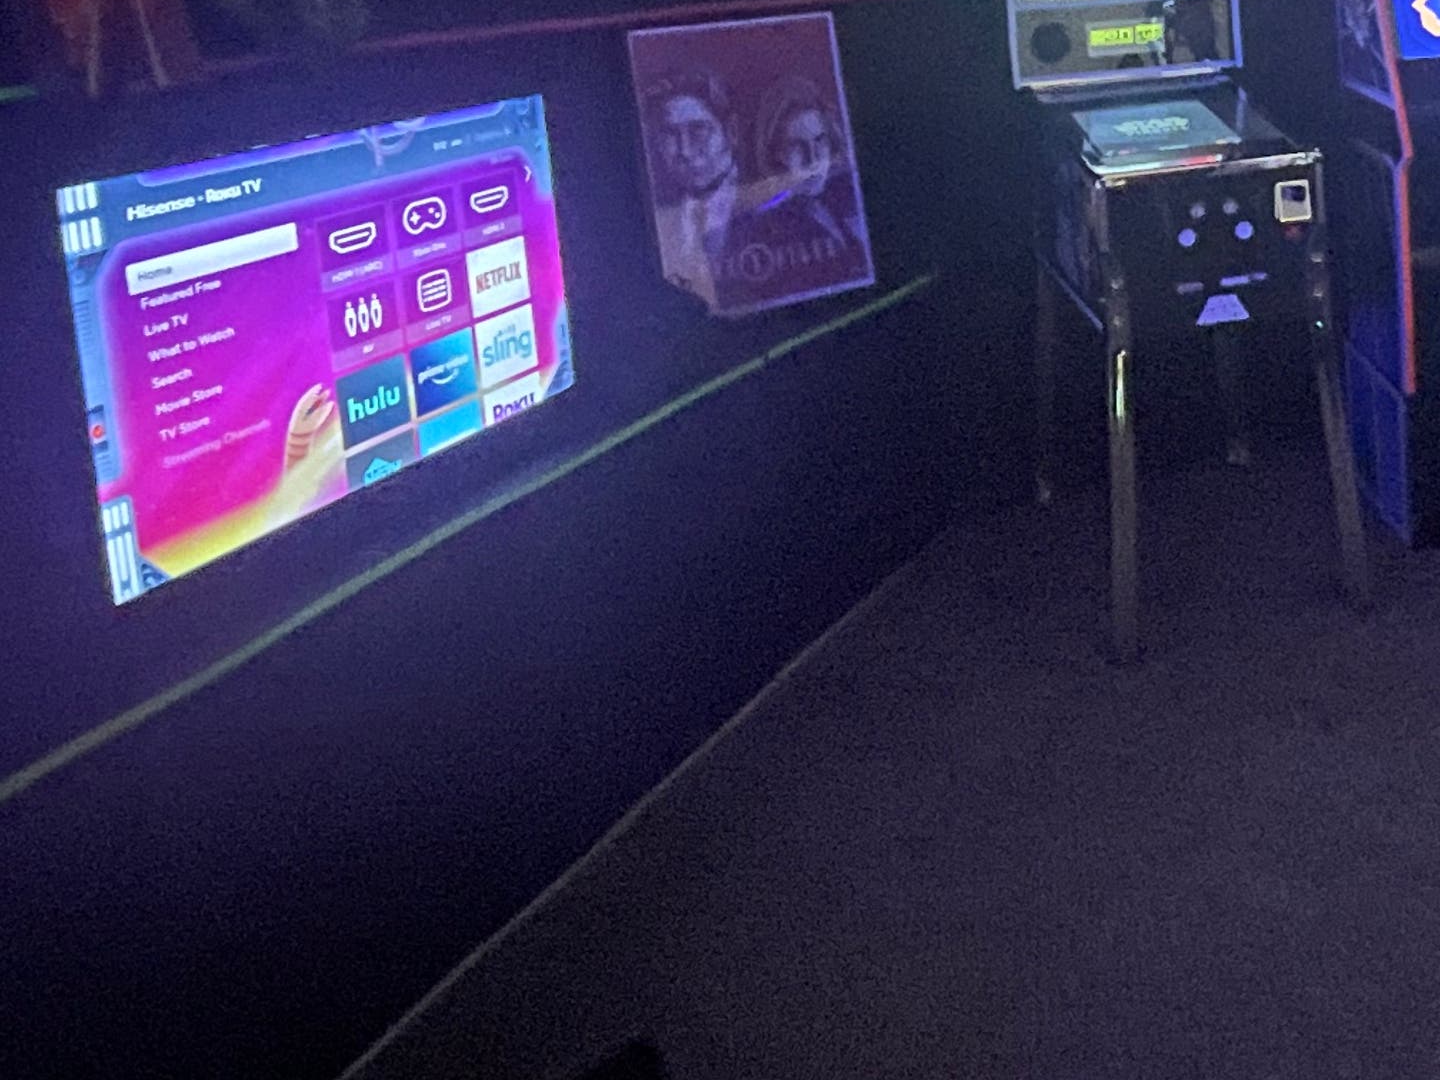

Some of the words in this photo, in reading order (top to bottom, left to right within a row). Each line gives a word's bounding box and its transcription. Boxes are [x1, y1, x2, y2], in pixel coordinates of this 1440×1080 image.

[126, 196, 196, 222] Hisense
[205, 185, 242, 203] Roku
[242, 178, 262, 194] TV
[137, 266, 172, 281] Home
[475, 261, 522, 294] NETFLIX
[140, 284, 194, 310] Featured
[143, 322, 169, 336] Live
[170, 313, 189, 328] TV
[147, 344, 182, 362] What
[182, 340, 197, 351] to
[198, 327, 235, 345] Watch
[482, 329, 533, 367] sling
[151, 368, 193, 389] Search
[192, 385, 223, 402] Store
[346, 386, 400, 424] hulu
[159, 425, 177, 441] TV
[179, 416, 210, 434] Store
